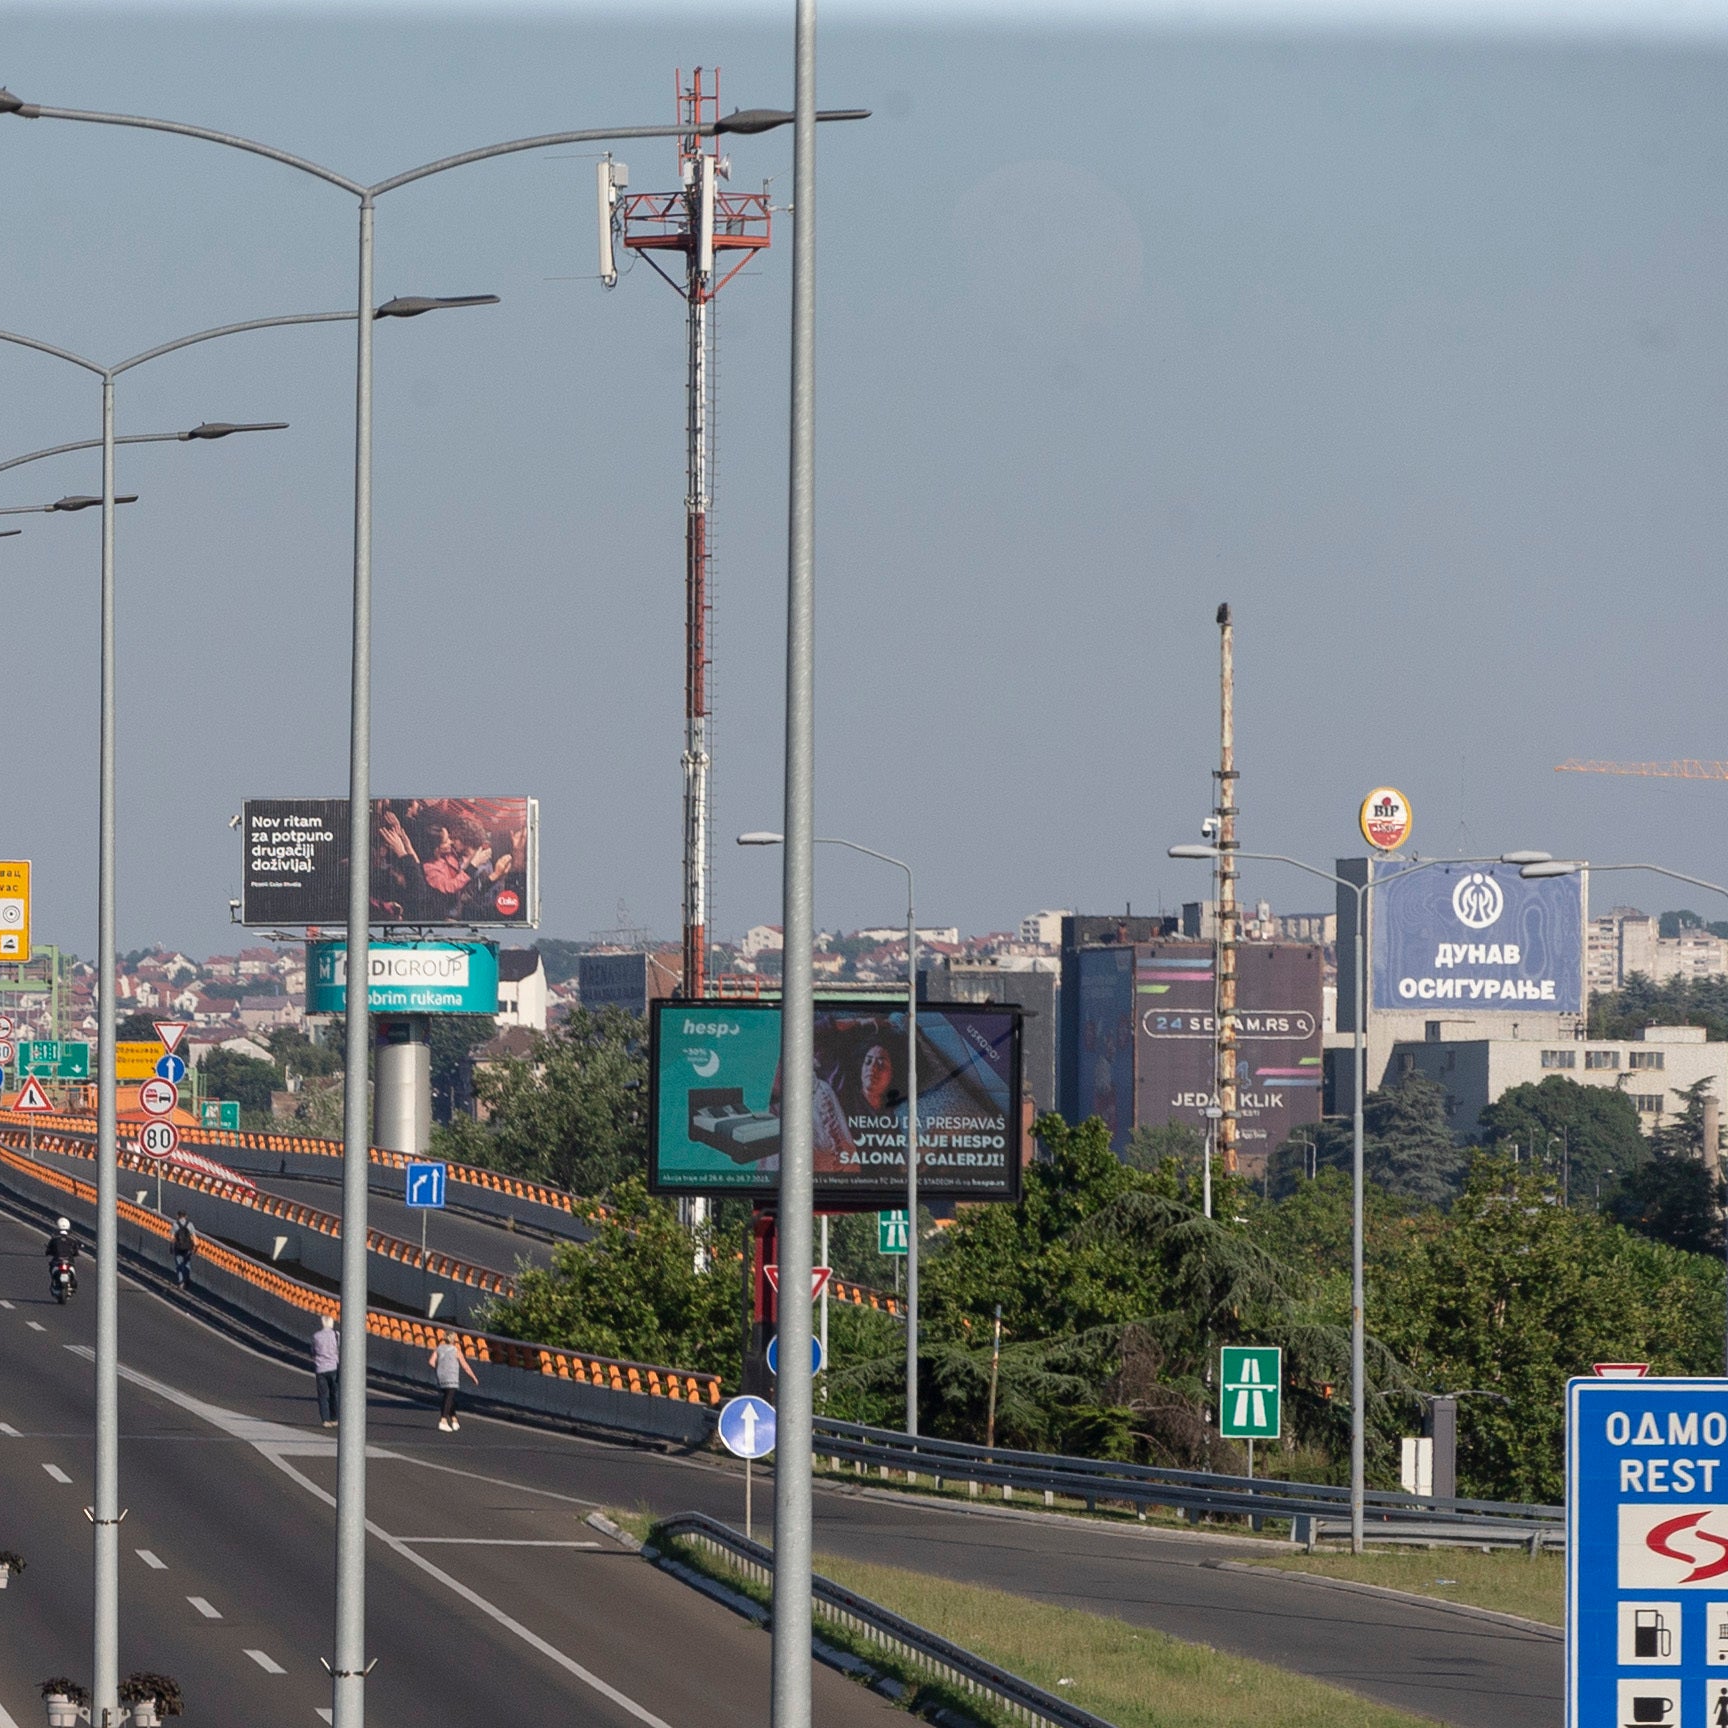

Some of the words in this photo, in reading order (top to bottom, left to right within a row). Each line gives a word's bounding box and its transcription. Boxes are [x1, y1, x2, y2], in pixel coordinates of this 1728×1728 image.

[1374, 804, 1400, 818] BIP
[251, 816, 281, 828] Nov
[283, 815, 323, 828] ritam
[251, 832, 269, 843] za
[271, 830, 334, 845] potpuno
[251, 844, 315, 859] drugačiji
[251, 858, 316, 873] doživljaj.
[1434, 943, 1521, 969] ДУНАВ
[1398, 977, 1557, 1001] ОСИГУРАЊЕ
[410, 990, 463, 1006] rukama
[1156, 1017, 1183, 1030] 24
[1189, 1017, 1290, 1032] SEAM.RS
[966, 1025, 1001, 1062] USKORO!
[1241, 1093, 1284, 1108] KLIK
[848, 1116, 899, 1129] NEMOJ
[926, 1115, 1005, 1131] PRESPAVAŠ
[147, 1128, 171, 1149] 80
[853, 1133, 948, 1148] OTVARNJE
[951, 1135, 1005, 1149] HESPO
[839, 1151, 905, 1165] SALONA
[924, 1153, 1005, 1167] GALERIJI!
[1620, 1458, 1721, 1494] REST
